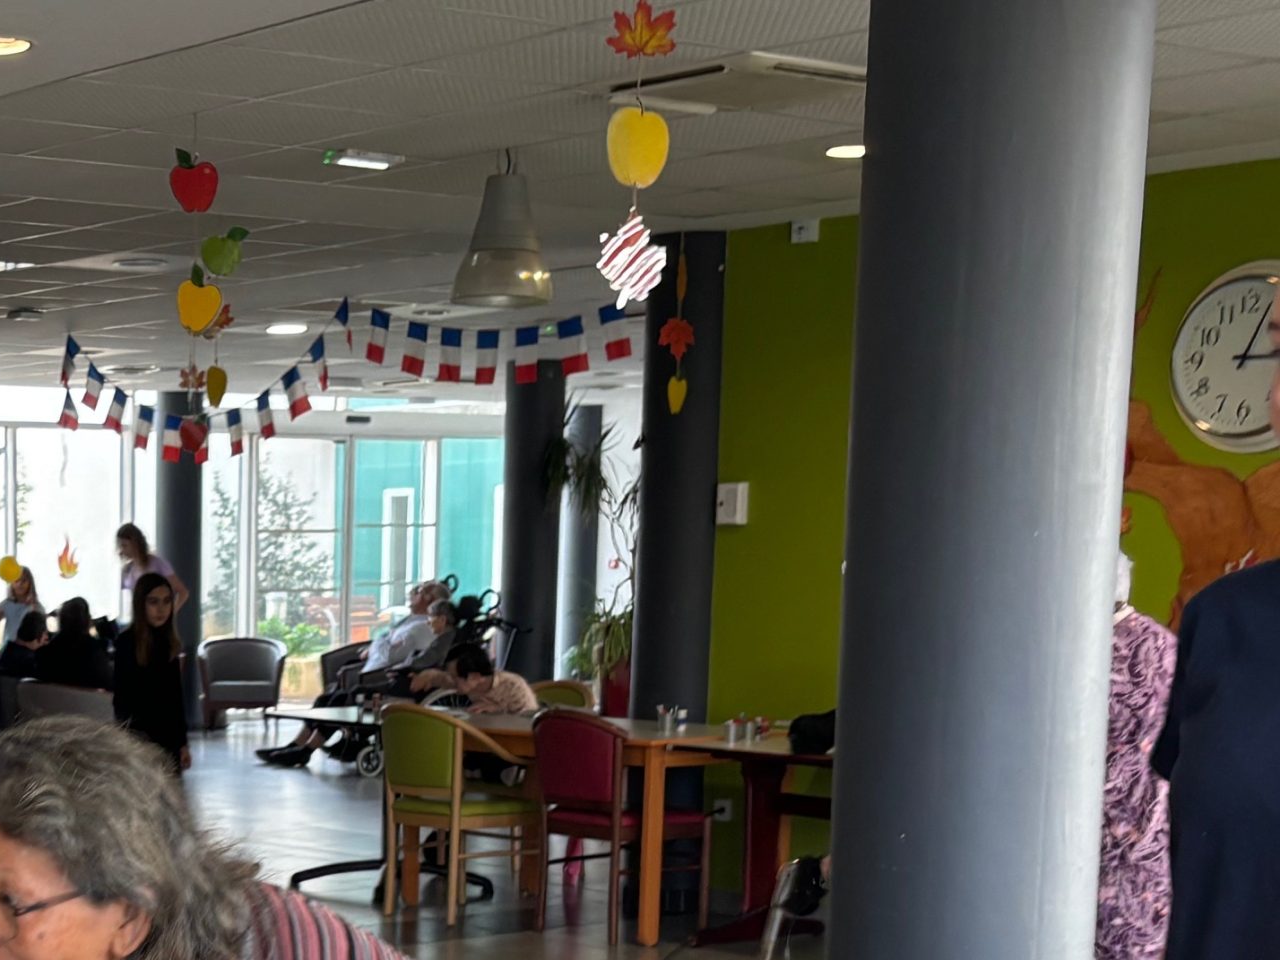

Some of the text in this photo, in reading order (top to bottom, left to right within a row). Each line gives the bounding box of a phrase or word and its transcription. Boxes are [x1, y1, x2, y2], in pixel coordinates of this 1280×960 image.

[1240, 289, 1260, 314] 12
[1219, 305, 1234, 325] 11
[1200, 327, 1220, 347] 10
[1190, 350, 1204, 372] 9
[1197, 376, 1210, 397] 8
[1216, 393, 1228, 413] 7
[1236, 399, 1251, 425] 6
